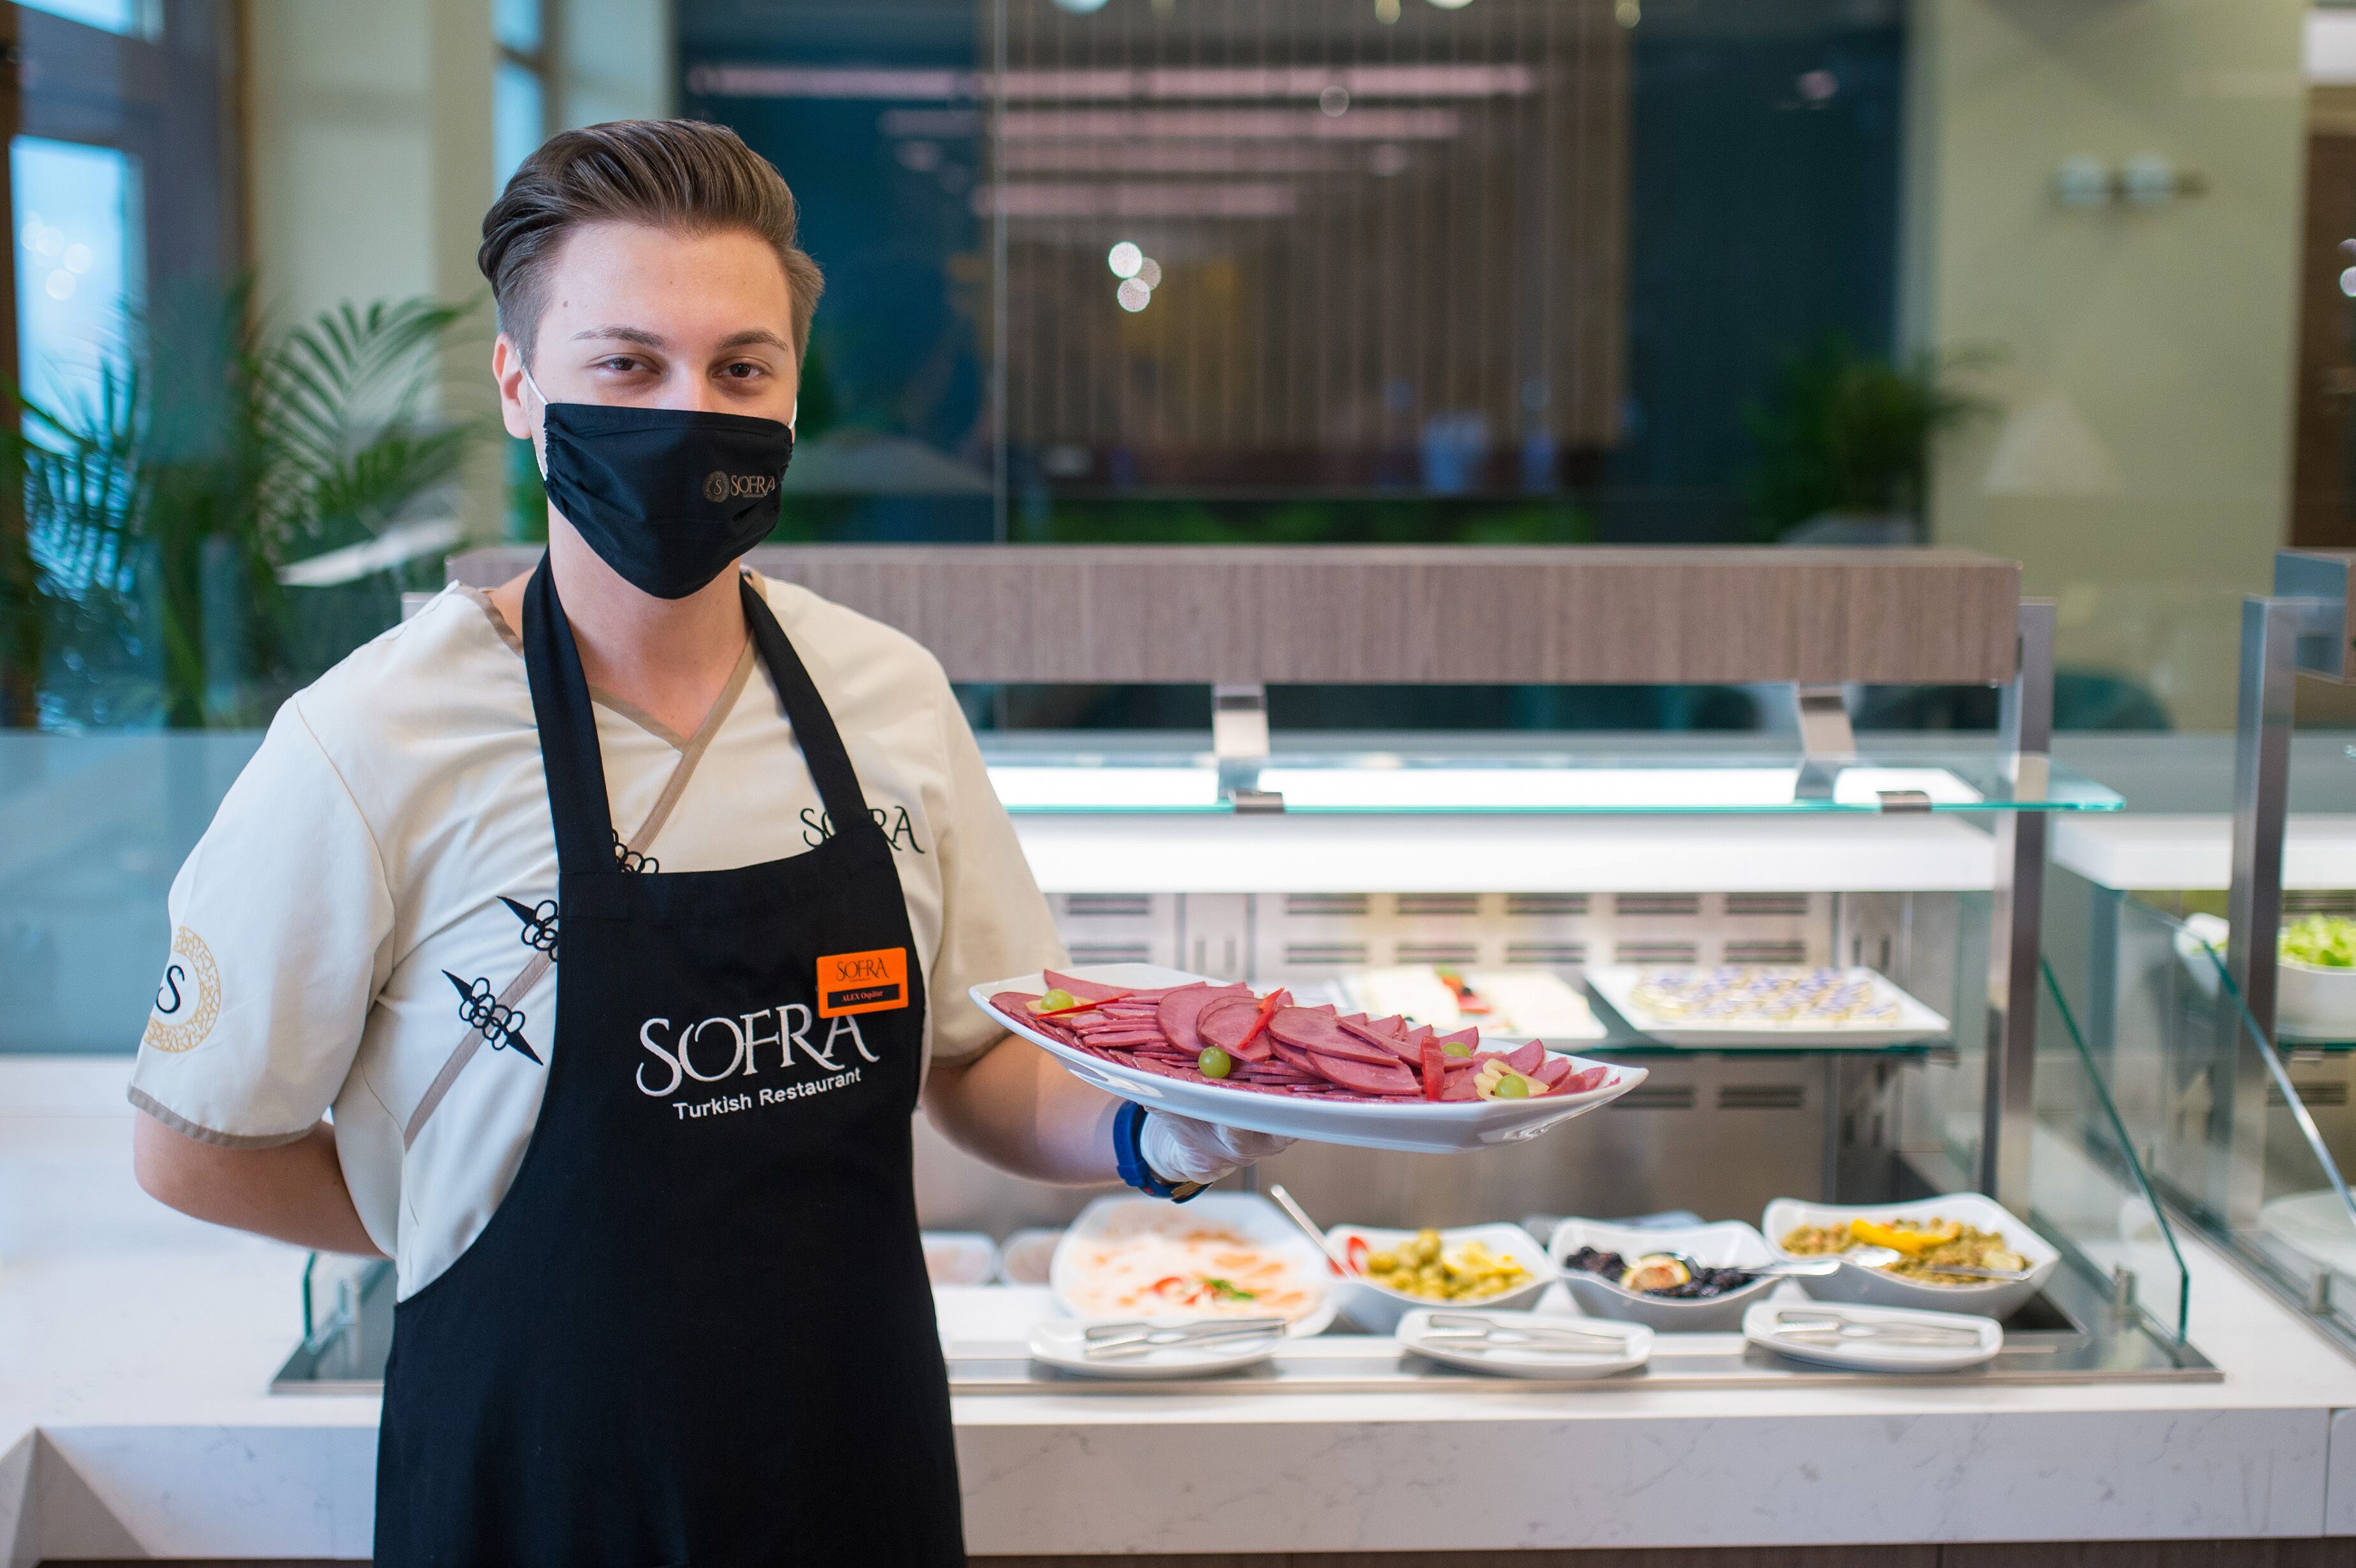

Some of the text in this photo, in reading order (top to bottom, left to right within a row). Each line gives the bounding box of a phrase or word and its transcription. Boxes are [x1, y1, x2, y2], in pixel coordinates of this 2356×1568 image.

[730, 475, 776, 497] SOFRA
[836, 957, 890, 982] SOFRA
[842, 992, 860, 1003] ALEX
[636, 1003, 880, 1097] SOFRA
[672, 1066, 862, 1120] Turkish Restaurant
